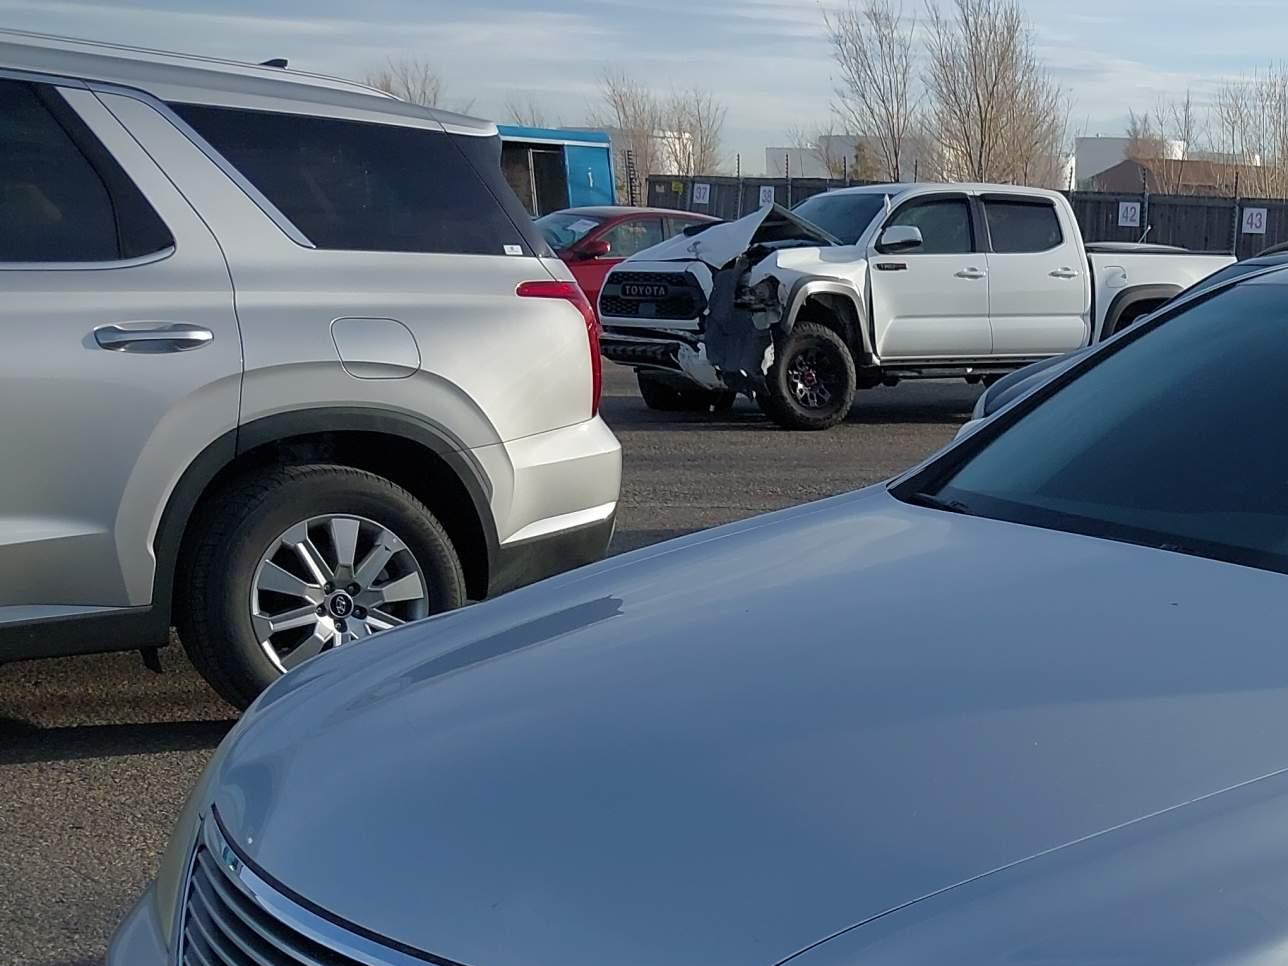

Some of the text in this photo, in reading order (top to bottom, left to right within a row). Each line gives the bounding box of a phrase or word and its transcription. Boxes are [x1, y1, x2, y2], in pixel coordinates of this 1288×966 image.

[695, 187, 708, 201] 37
[1121, 206, 1138, 223] 42
[1245, 212, 1263, 229] 43
[625, 285, 665, 296] TOYOTA
